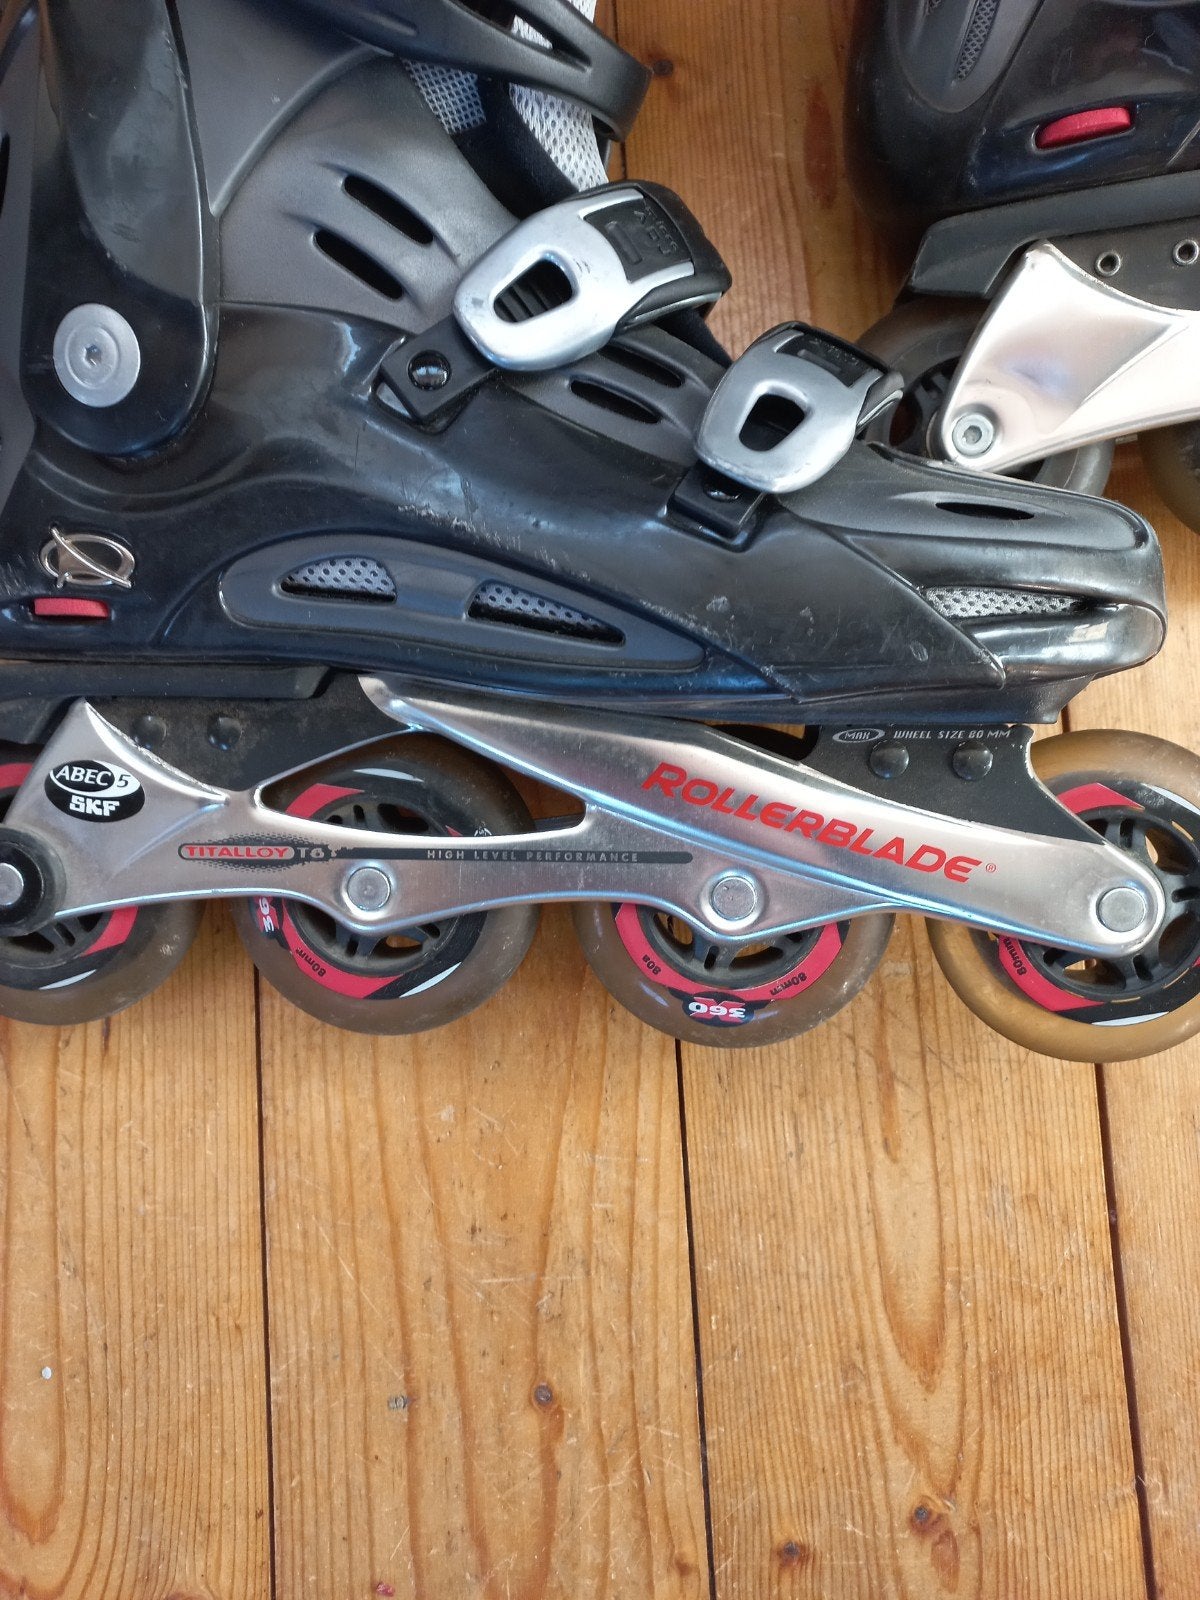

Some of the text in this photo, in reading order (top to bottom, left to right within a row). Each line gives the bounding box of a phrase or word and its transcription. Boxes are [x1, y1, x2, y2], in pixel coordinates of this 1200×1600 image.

[893, 729, 1011, 739] WHEEL SIZE 80 MM
[55, 765, 131, 788] ABEC 5
[69, 794, 120, 816] SKF
[185, 846, 290, 858] TITALLOY
[427, 849, 639, 863] HIGH LEVEL PERFORMANCE
[258, 896, 275, 933] 36
